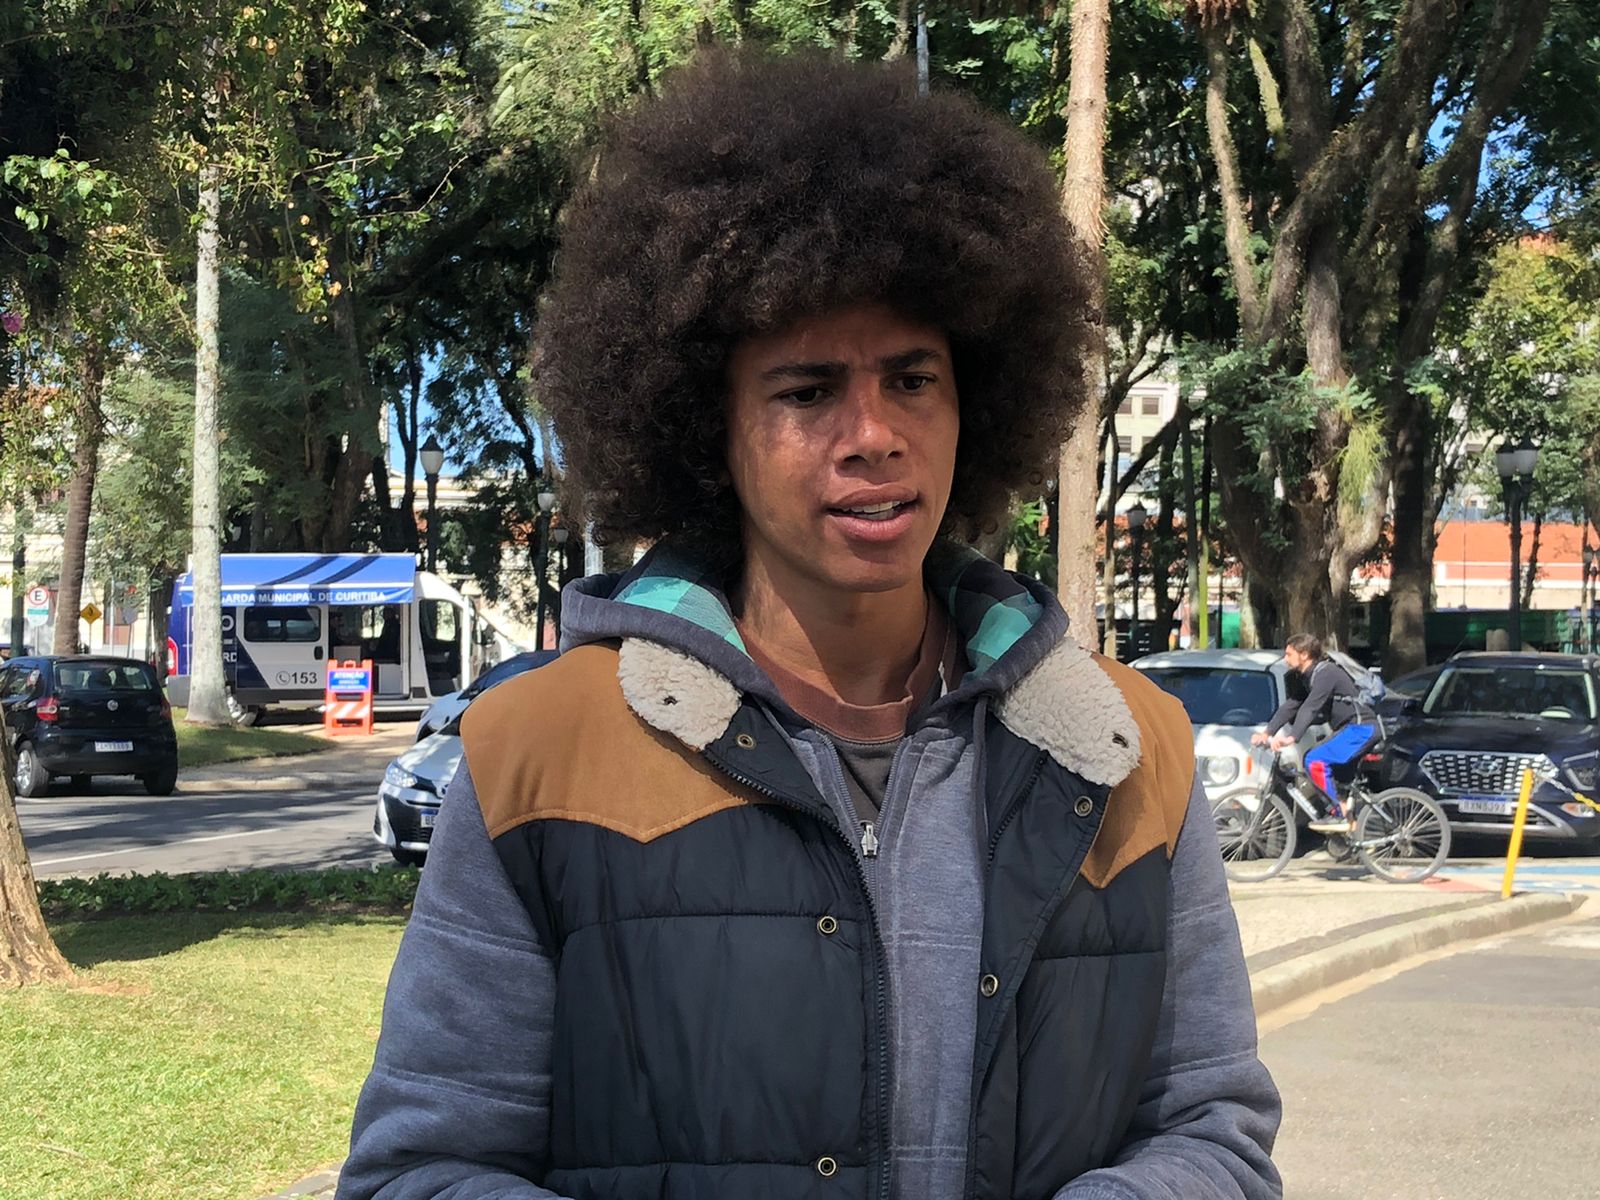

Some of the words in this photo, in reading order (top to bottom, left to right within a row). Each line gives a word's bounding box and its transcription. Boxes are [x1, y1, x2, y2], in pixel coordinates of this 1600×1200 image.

[34, 590, 43, 601] E
[221, 593, 256, 603] ARDA
[258, 592, 317, 603] MUNICIPAL
[318, 592, 333, 602] DE
[335, 591, 387, 602] CURITIBA
[291, 671, 318, 685] 153
